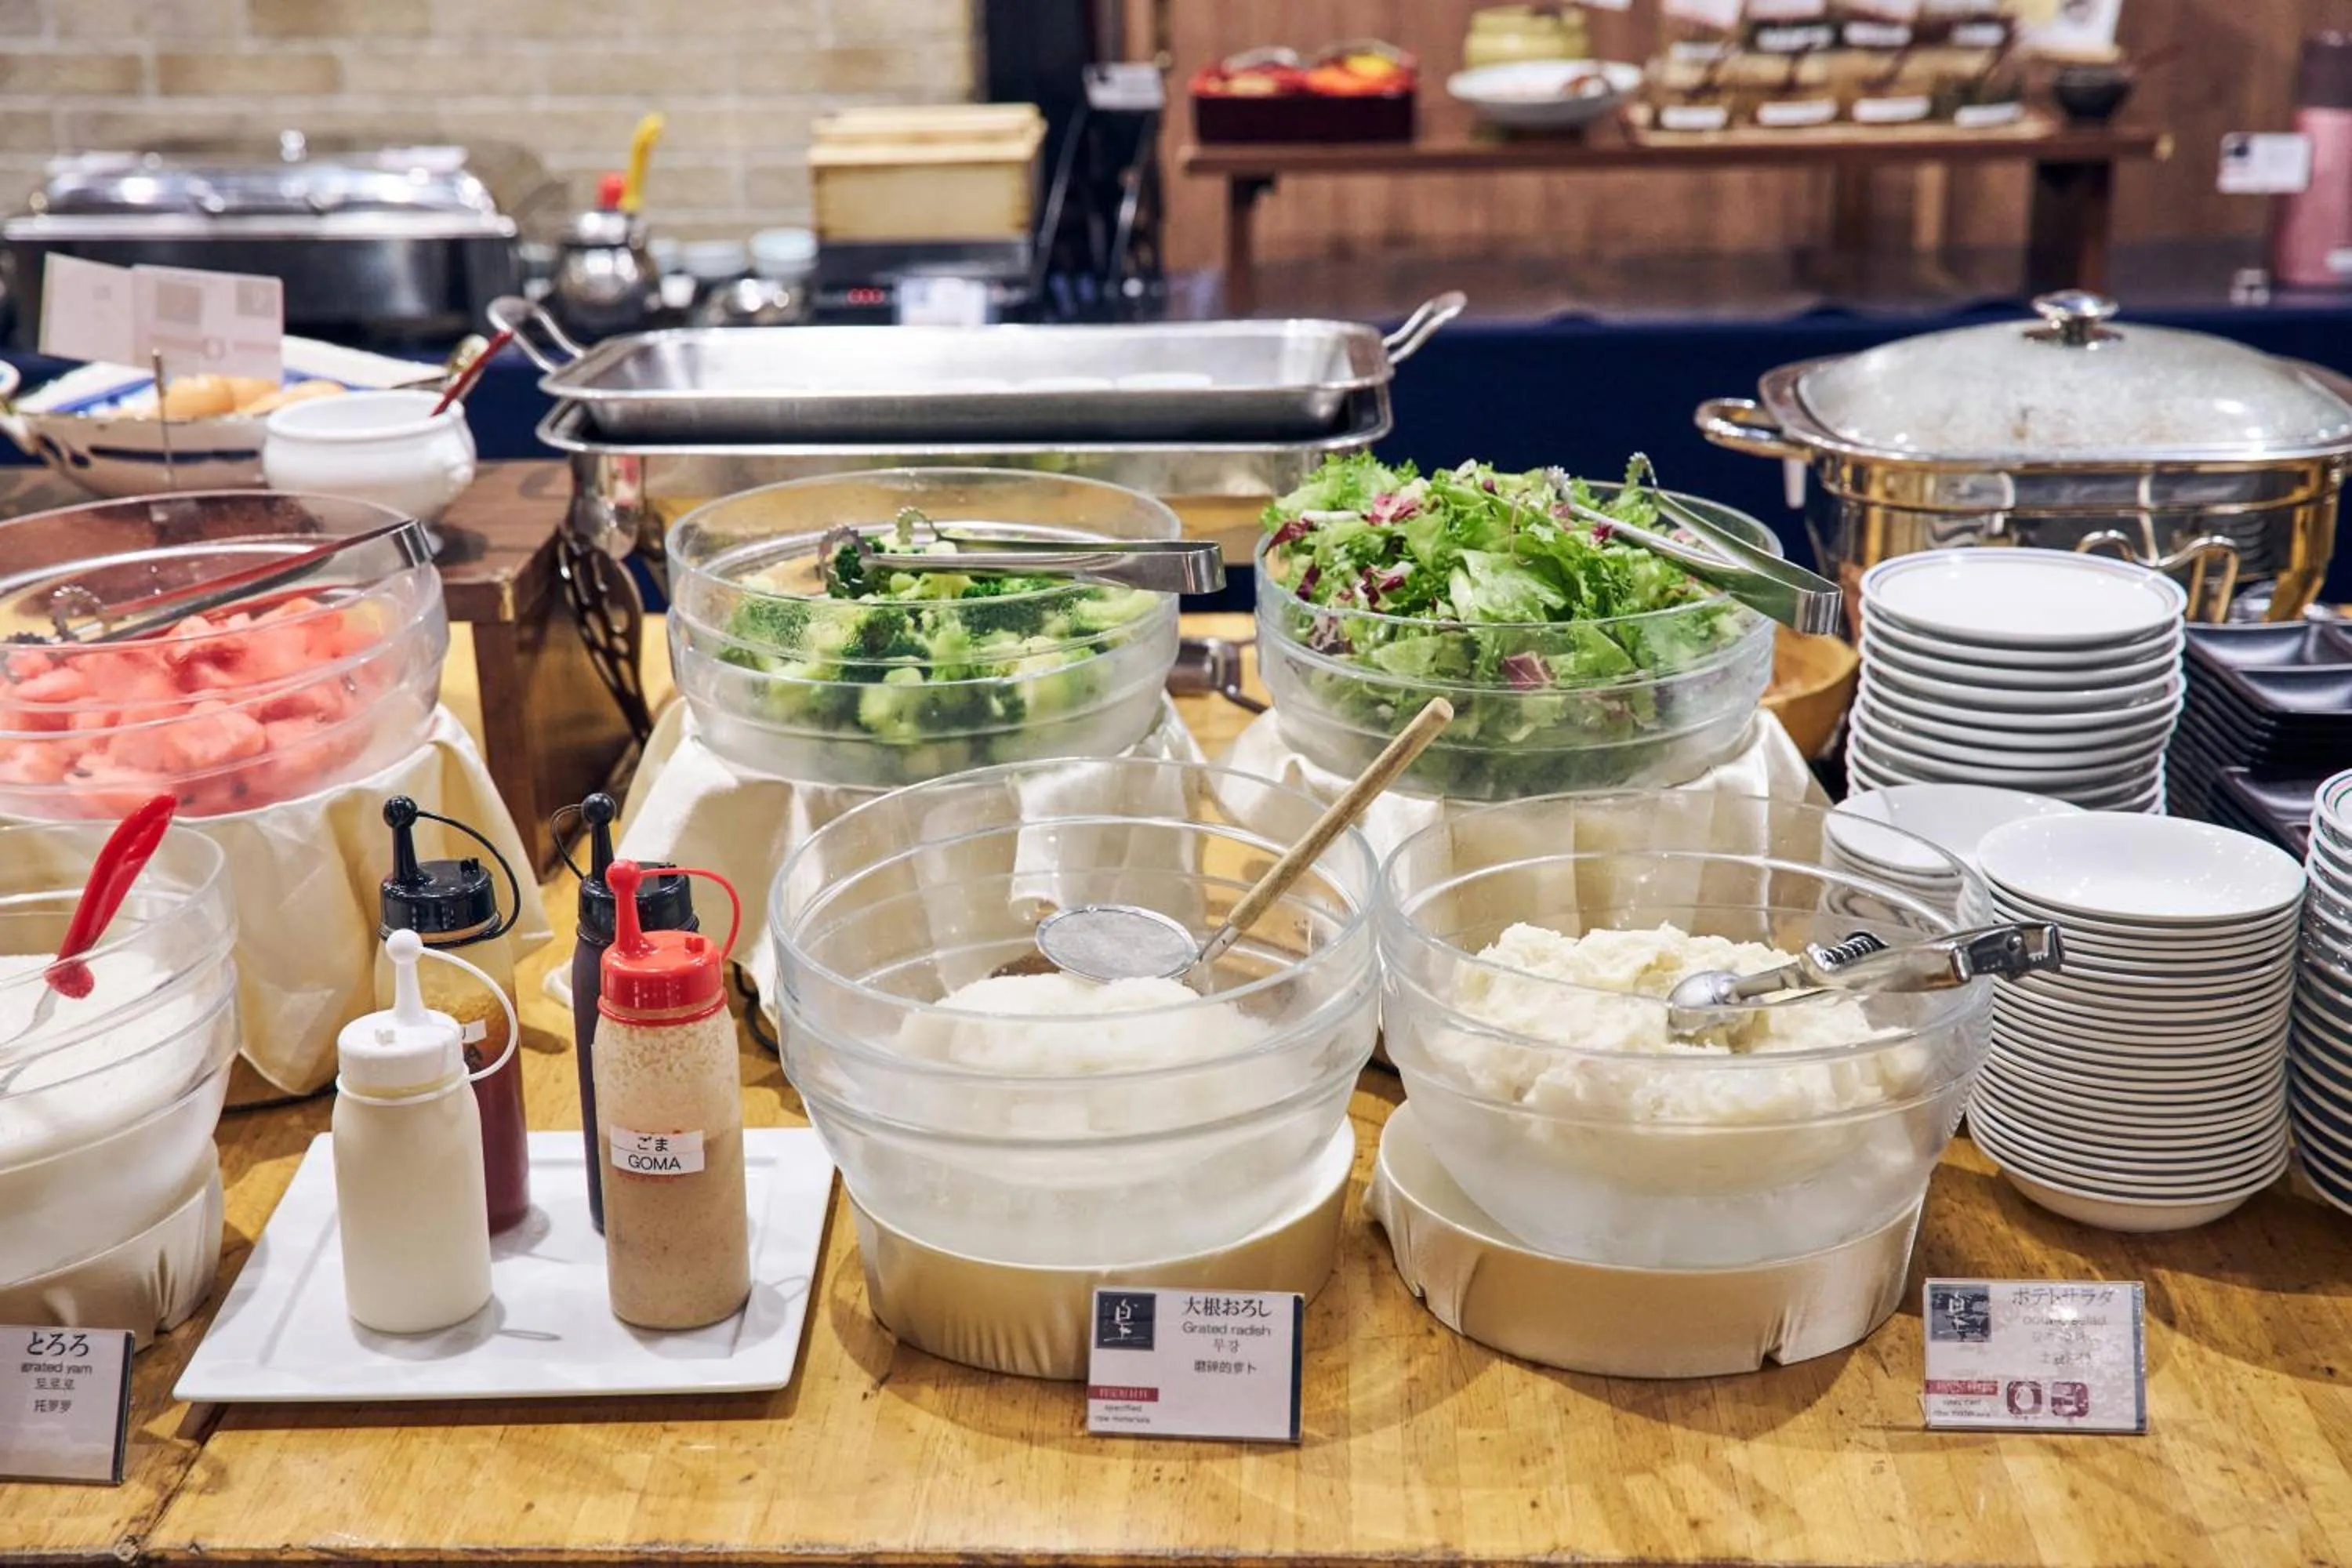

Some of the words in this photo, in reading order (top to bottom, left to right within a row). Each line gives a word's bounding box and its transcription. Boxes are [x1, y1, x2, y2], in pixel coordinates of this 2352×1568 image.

[637, 1136, 668, 1152] ごま
[628, 1154, 681, 1171] GOMA
[1181, 1296, 1272, 1318] 大根おろし
[1182, 1320, 1228, 1334] Grated
[1230, 1323, 1271, 1337] radish
[27, 1331, 89, 1357] とろろ
[21, 1362, 63, 1374] grated
[67, 1364, 93, 1375] yam
